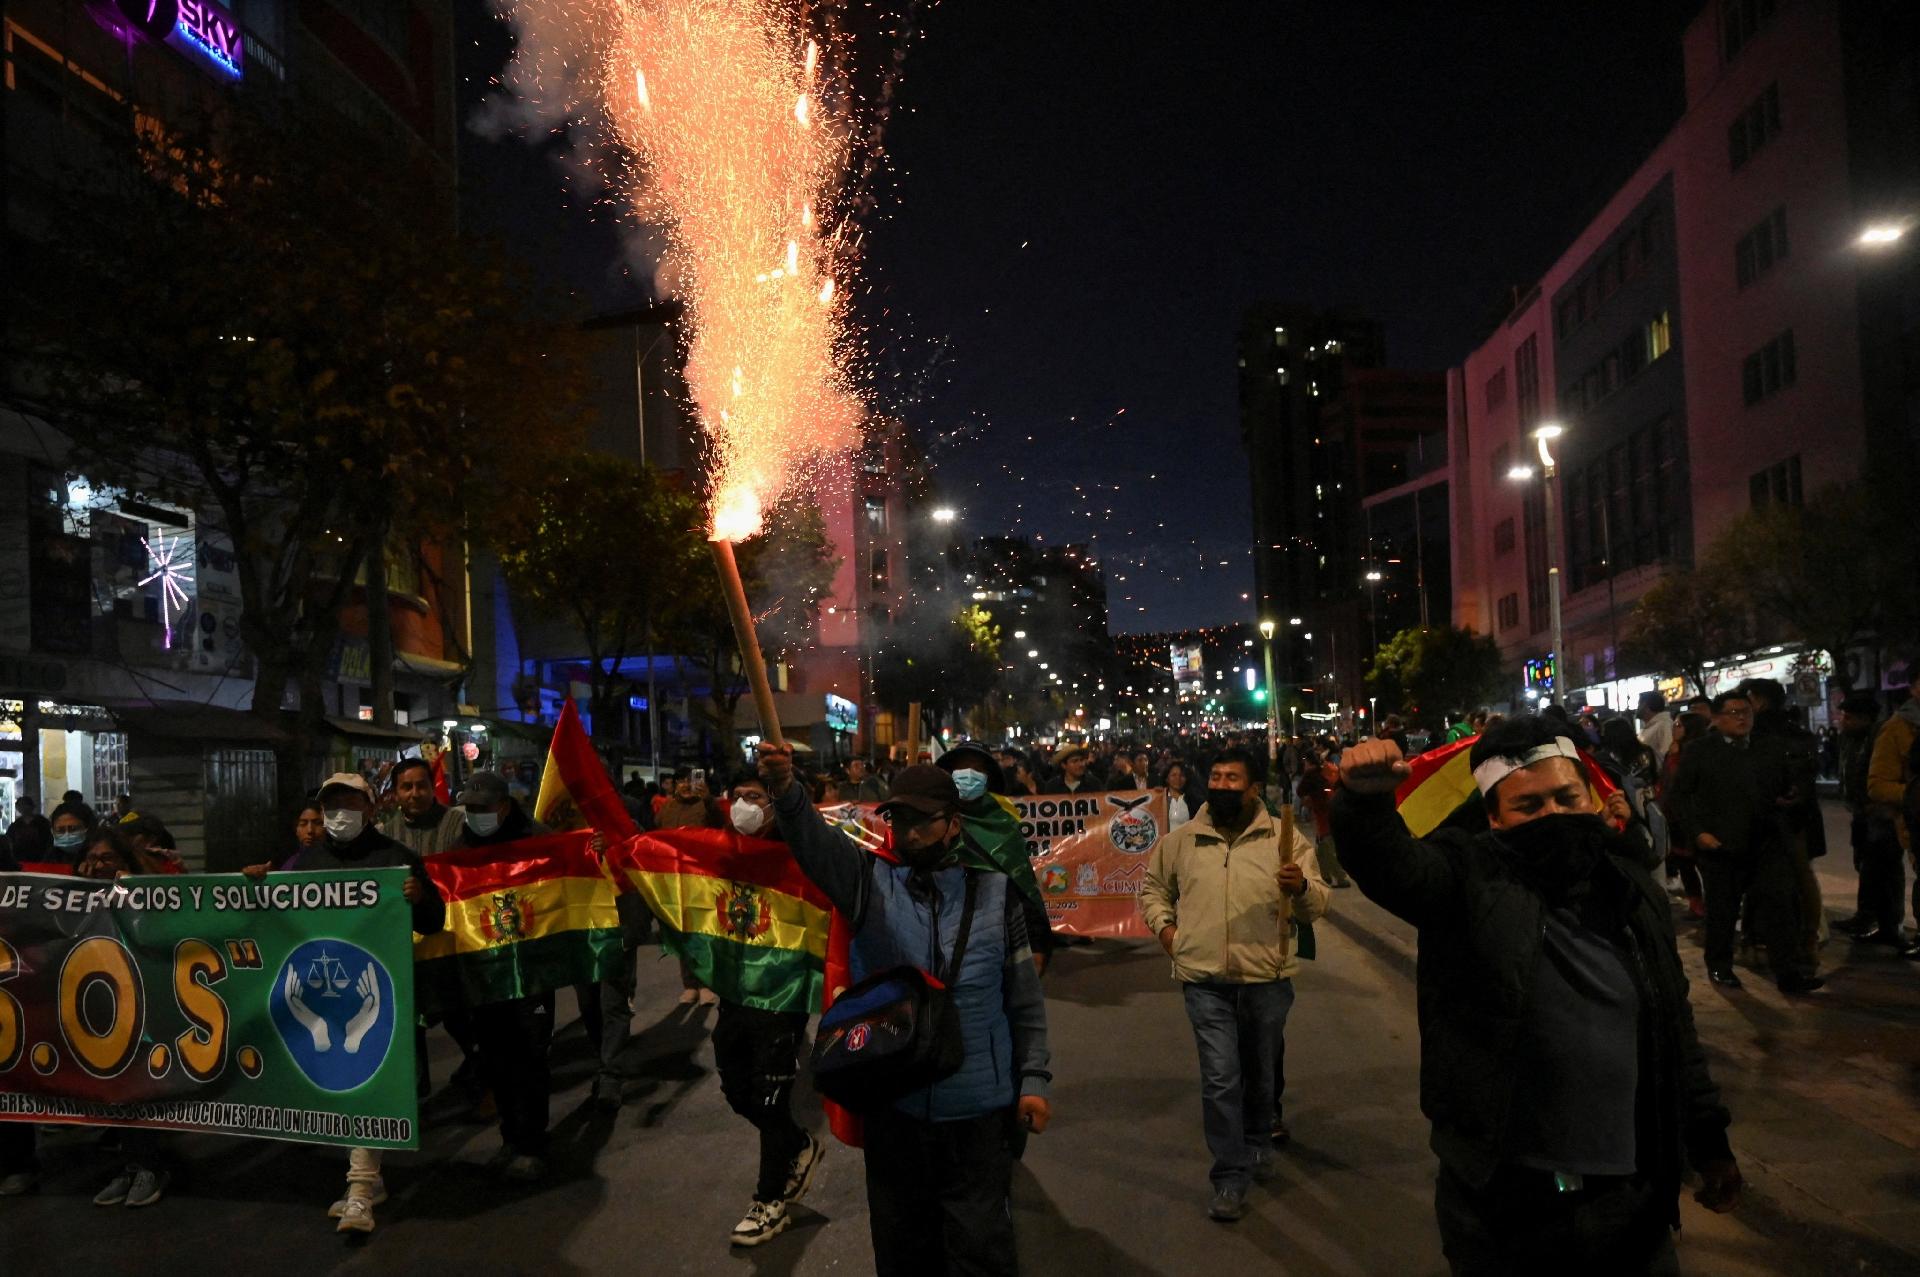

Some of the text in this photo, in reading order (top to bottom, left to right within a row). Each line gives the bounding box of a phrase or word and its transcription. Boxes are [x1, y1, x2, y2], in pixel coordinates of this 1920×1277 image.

[180, 0, 240, 56] SKY
[0, 879, 380, 913] DE SERVICIOS Y SOLUCIONES
[166, 1101, 249, 1128] SOLUCIONES
[248, 1104, 281, 1131] PARA
[283, 1108, 301, 1132] UN
[302, 1109, 351, 1138] FUTURO
[353, 1114, 412, 1143] SEGURO
